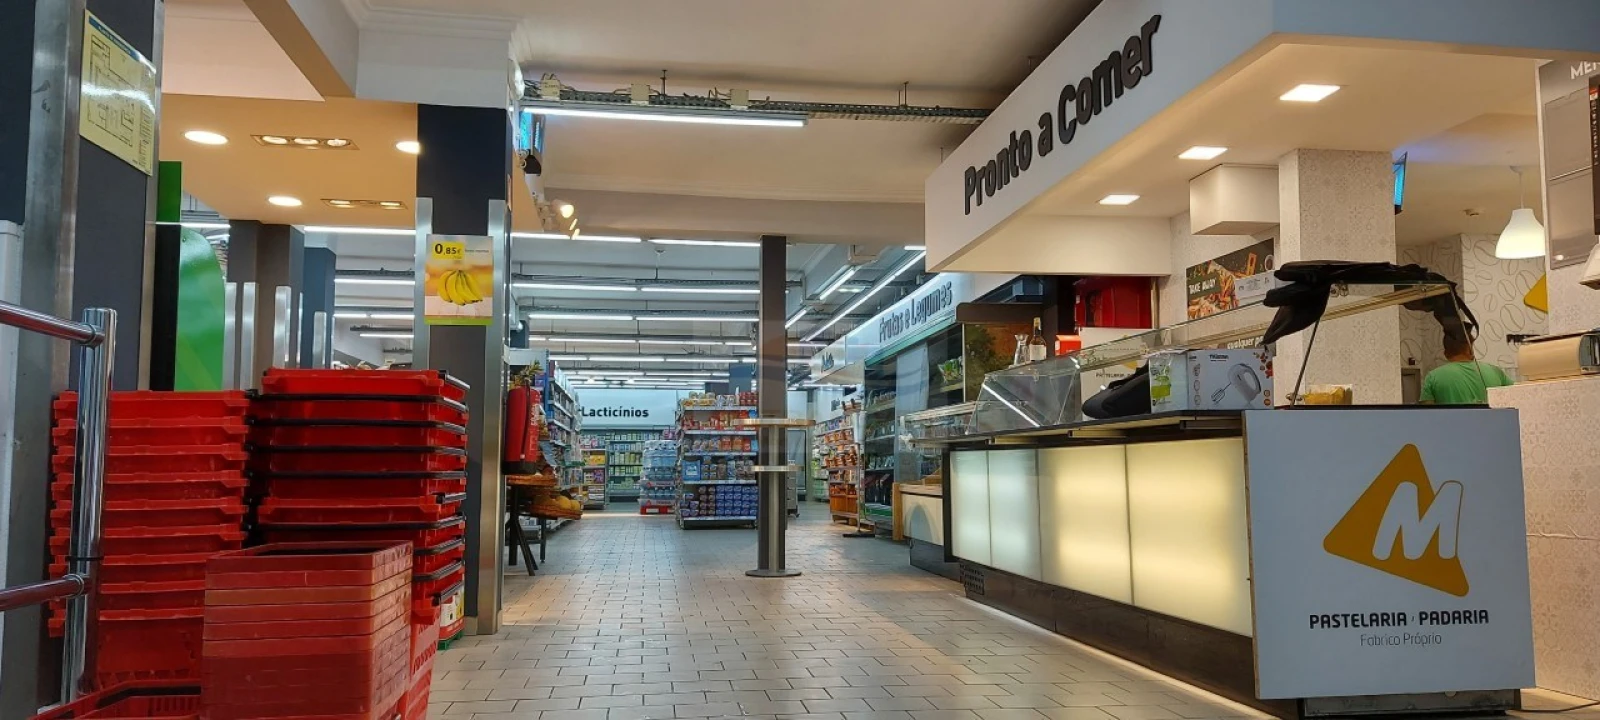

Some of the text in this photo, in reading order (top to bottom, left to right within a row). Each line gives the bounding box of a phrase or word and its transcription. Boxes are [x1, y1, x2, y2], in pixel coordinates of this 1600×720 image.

[964, 14, 1162, 215] Pronto a Comer
[1188, 276, 1217, 295] TAKE AWAY
[879, 281, 953, 343] Frutas e Legumes
[581, 405, 649, 417] Lacticínios
[1309, 609, 1489, 630] PASTELARIA PADARIA
[1360, 632, 1442, 647] Fabrico Próprio
